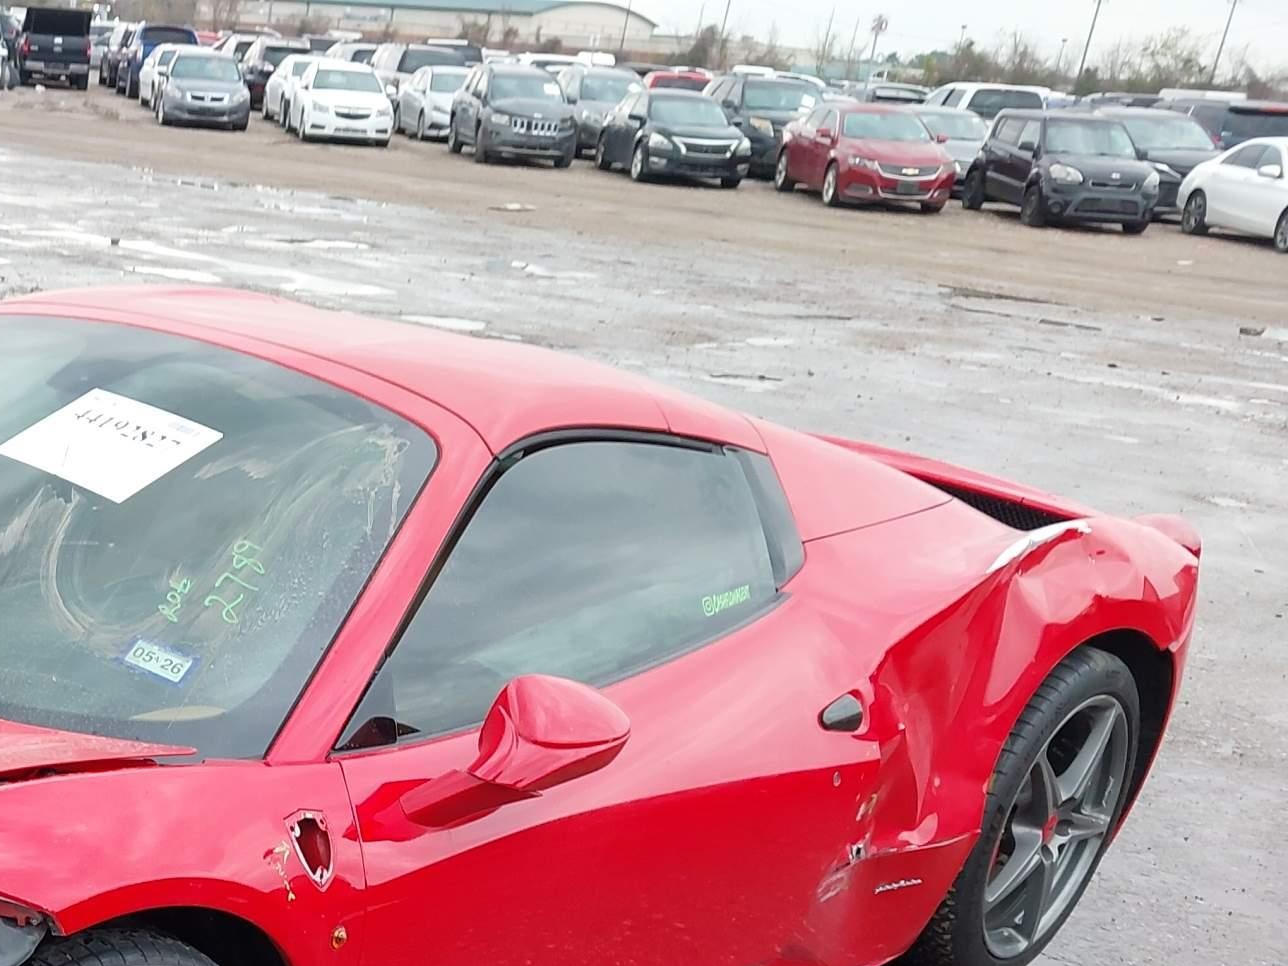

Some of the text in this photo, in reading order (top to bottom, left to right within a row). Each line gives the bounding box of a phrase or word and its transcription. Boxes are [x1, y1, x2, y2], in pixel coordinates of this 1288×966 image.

[204, 540, 265, 624] 2789
[132, 646, 184, 675] 05 26
